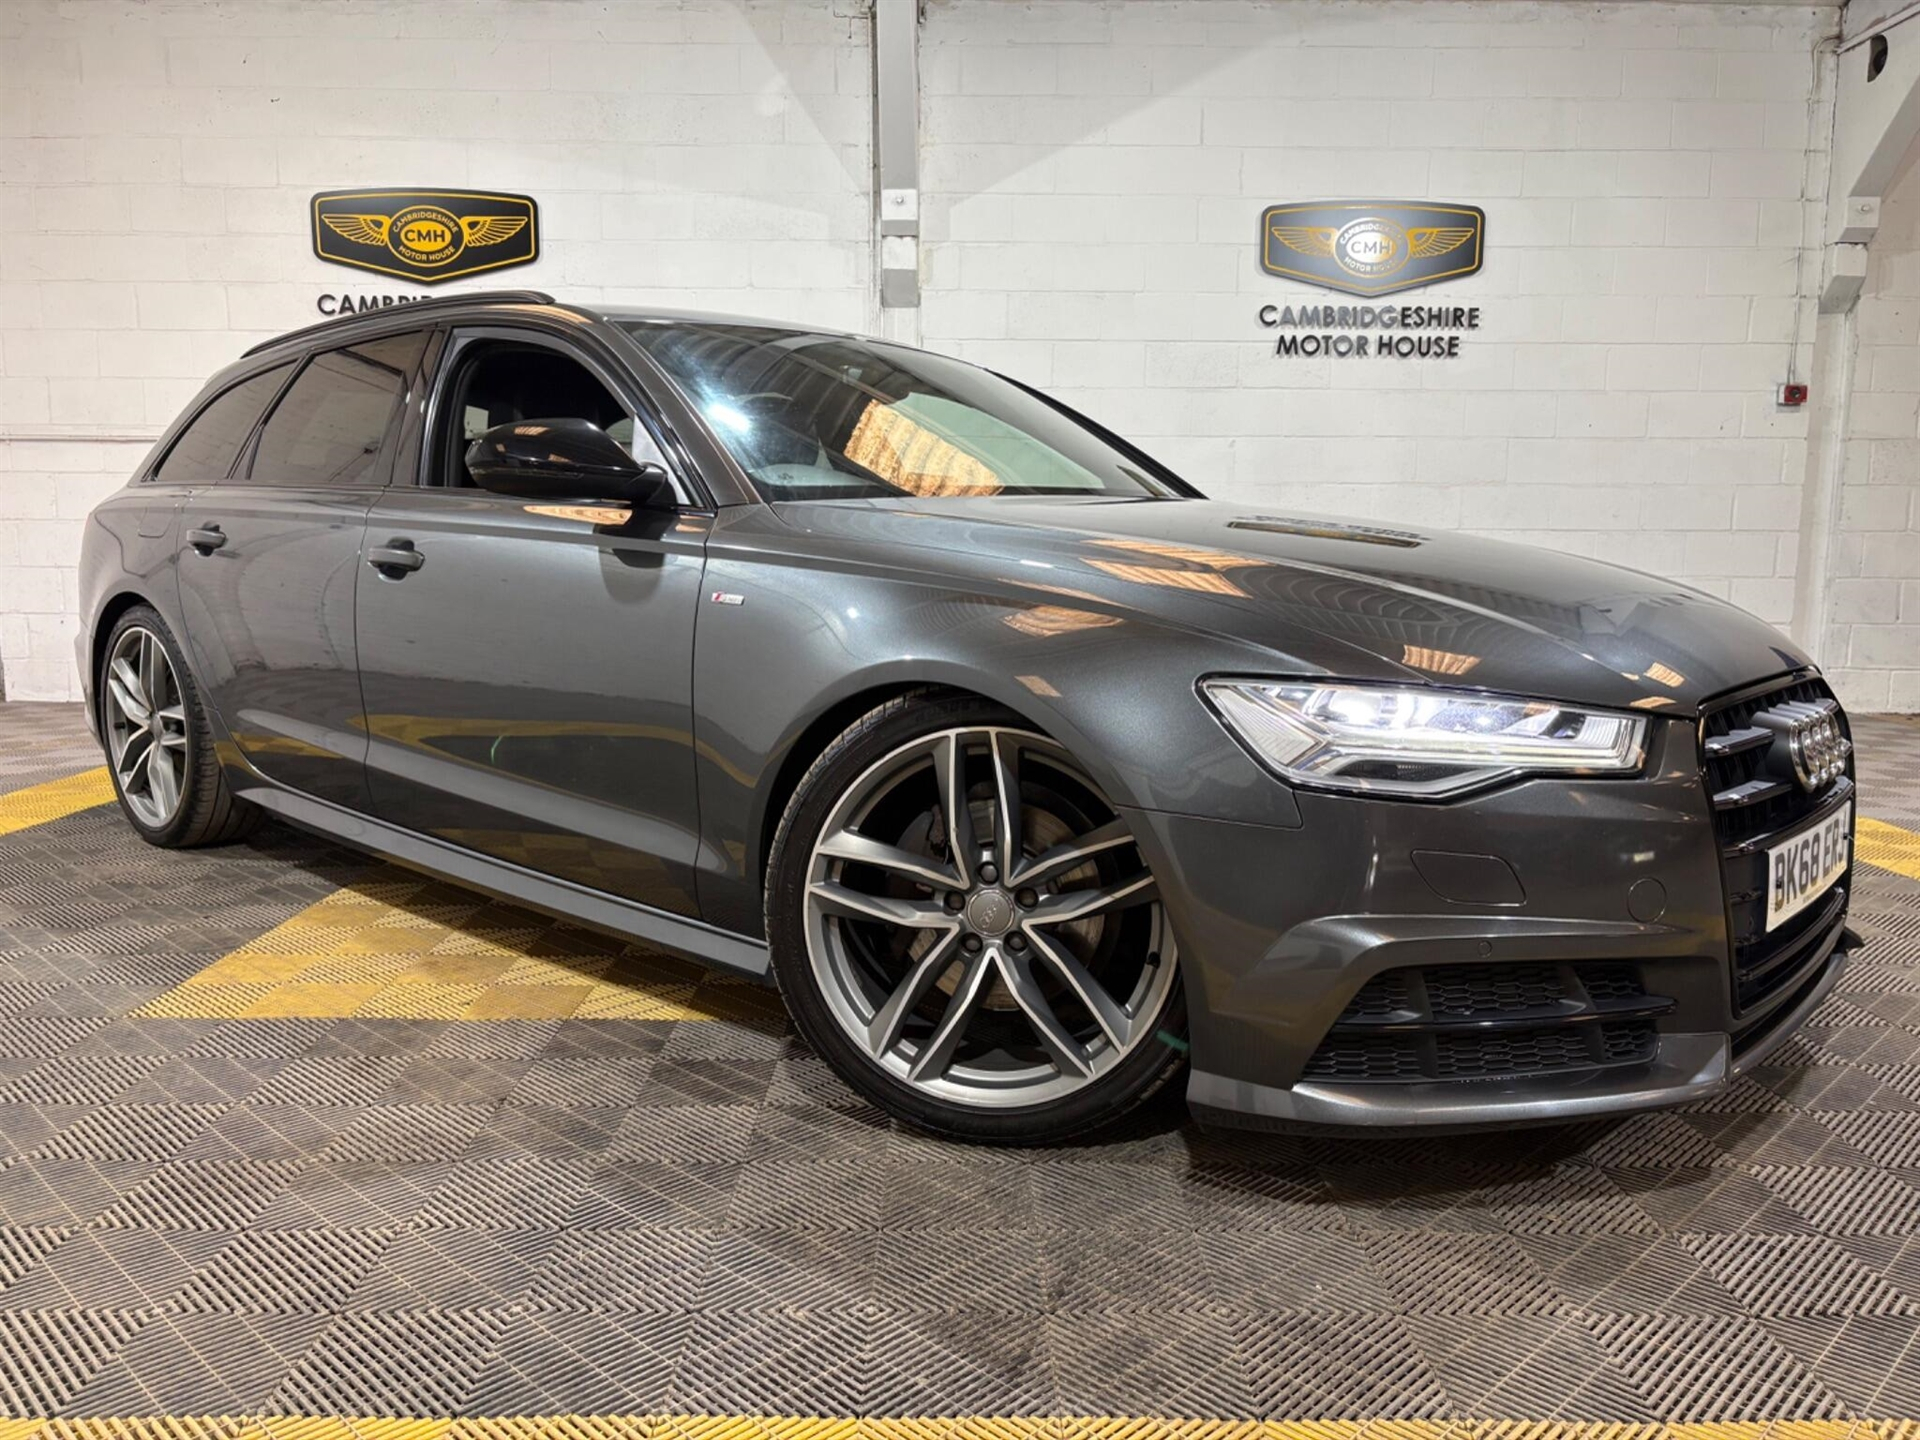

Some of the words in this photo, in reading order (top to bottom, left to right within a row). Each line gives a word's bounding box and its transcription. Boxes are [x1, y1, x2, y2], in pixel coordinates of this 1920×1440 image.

[404, 229, 446, 242] CMH
[398, 245, 427, 261] MOTOR
[428, 245, 456, 261] HOUSE
[1351, 241, 1392, 254] CMH
[1343, 256, 1371, 273] MOTOR
[1259, 304, 1480, 328] CAMBRIDGESHIRE
[1276, 335, 1369, 356] MOTOR
[1378, 335, 1460, 357] HOUSE
[1774, 832, 1820, 912] BK68
